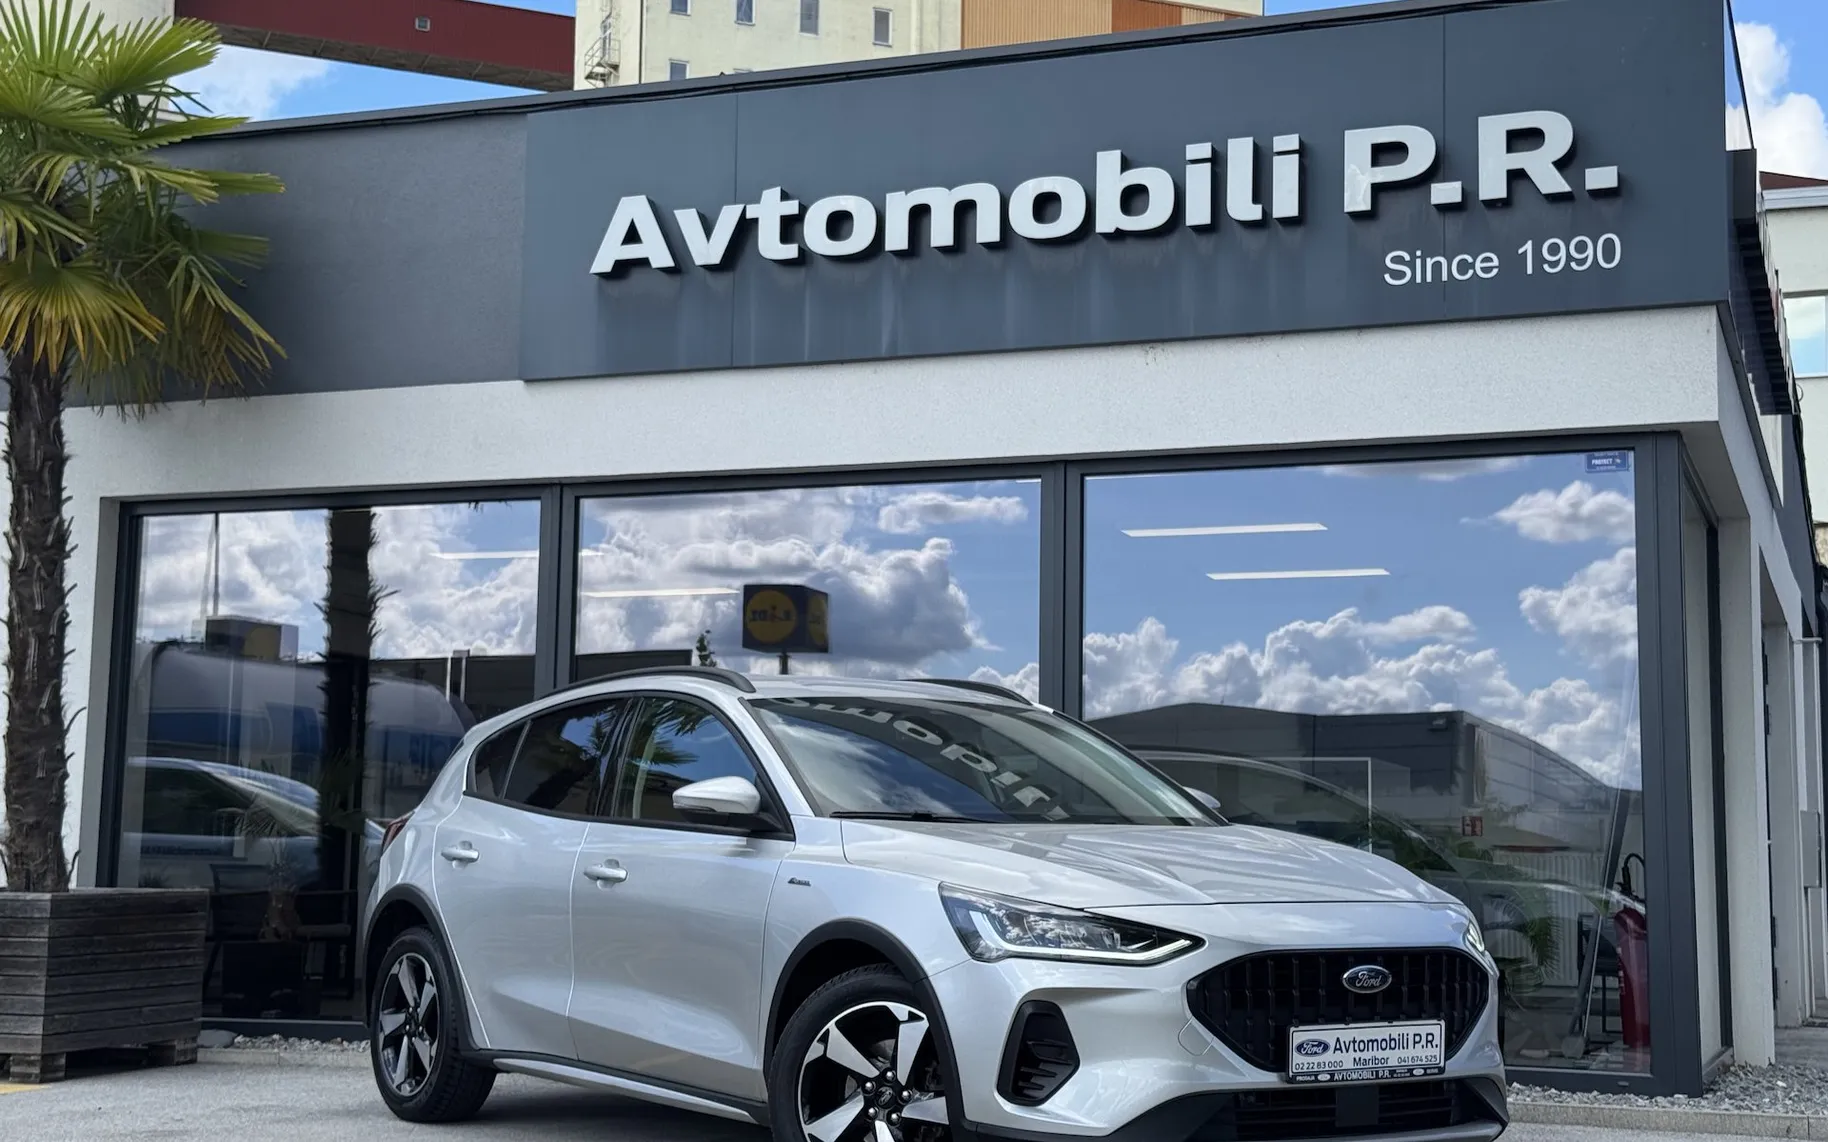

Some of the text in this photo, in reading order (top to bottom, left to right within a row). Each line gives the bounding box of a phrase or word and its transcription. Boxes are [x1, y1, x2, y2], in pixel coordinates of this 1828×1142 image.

[589, 109, 1620, 275] Avtomobili P.R.
[1383, 232, 1623, 286] Since 1990
[1355, 970, 1381, 986] Ford
[1301, 1041, 1324, 1054] Ford
[1333, 1032, 1439, 1054] Avtomobili P.R.
[1295, 1060, 1344, 1071] 02 22 83 000
[1353, 1057, 1389, 1067] Maribor
[1397, 1054, 1438, 1064] 041 674 525
[1333, 1071, 1376, 1081] AVTOMOBILI
[1378, 1070, 1392, 1079] P.R.
